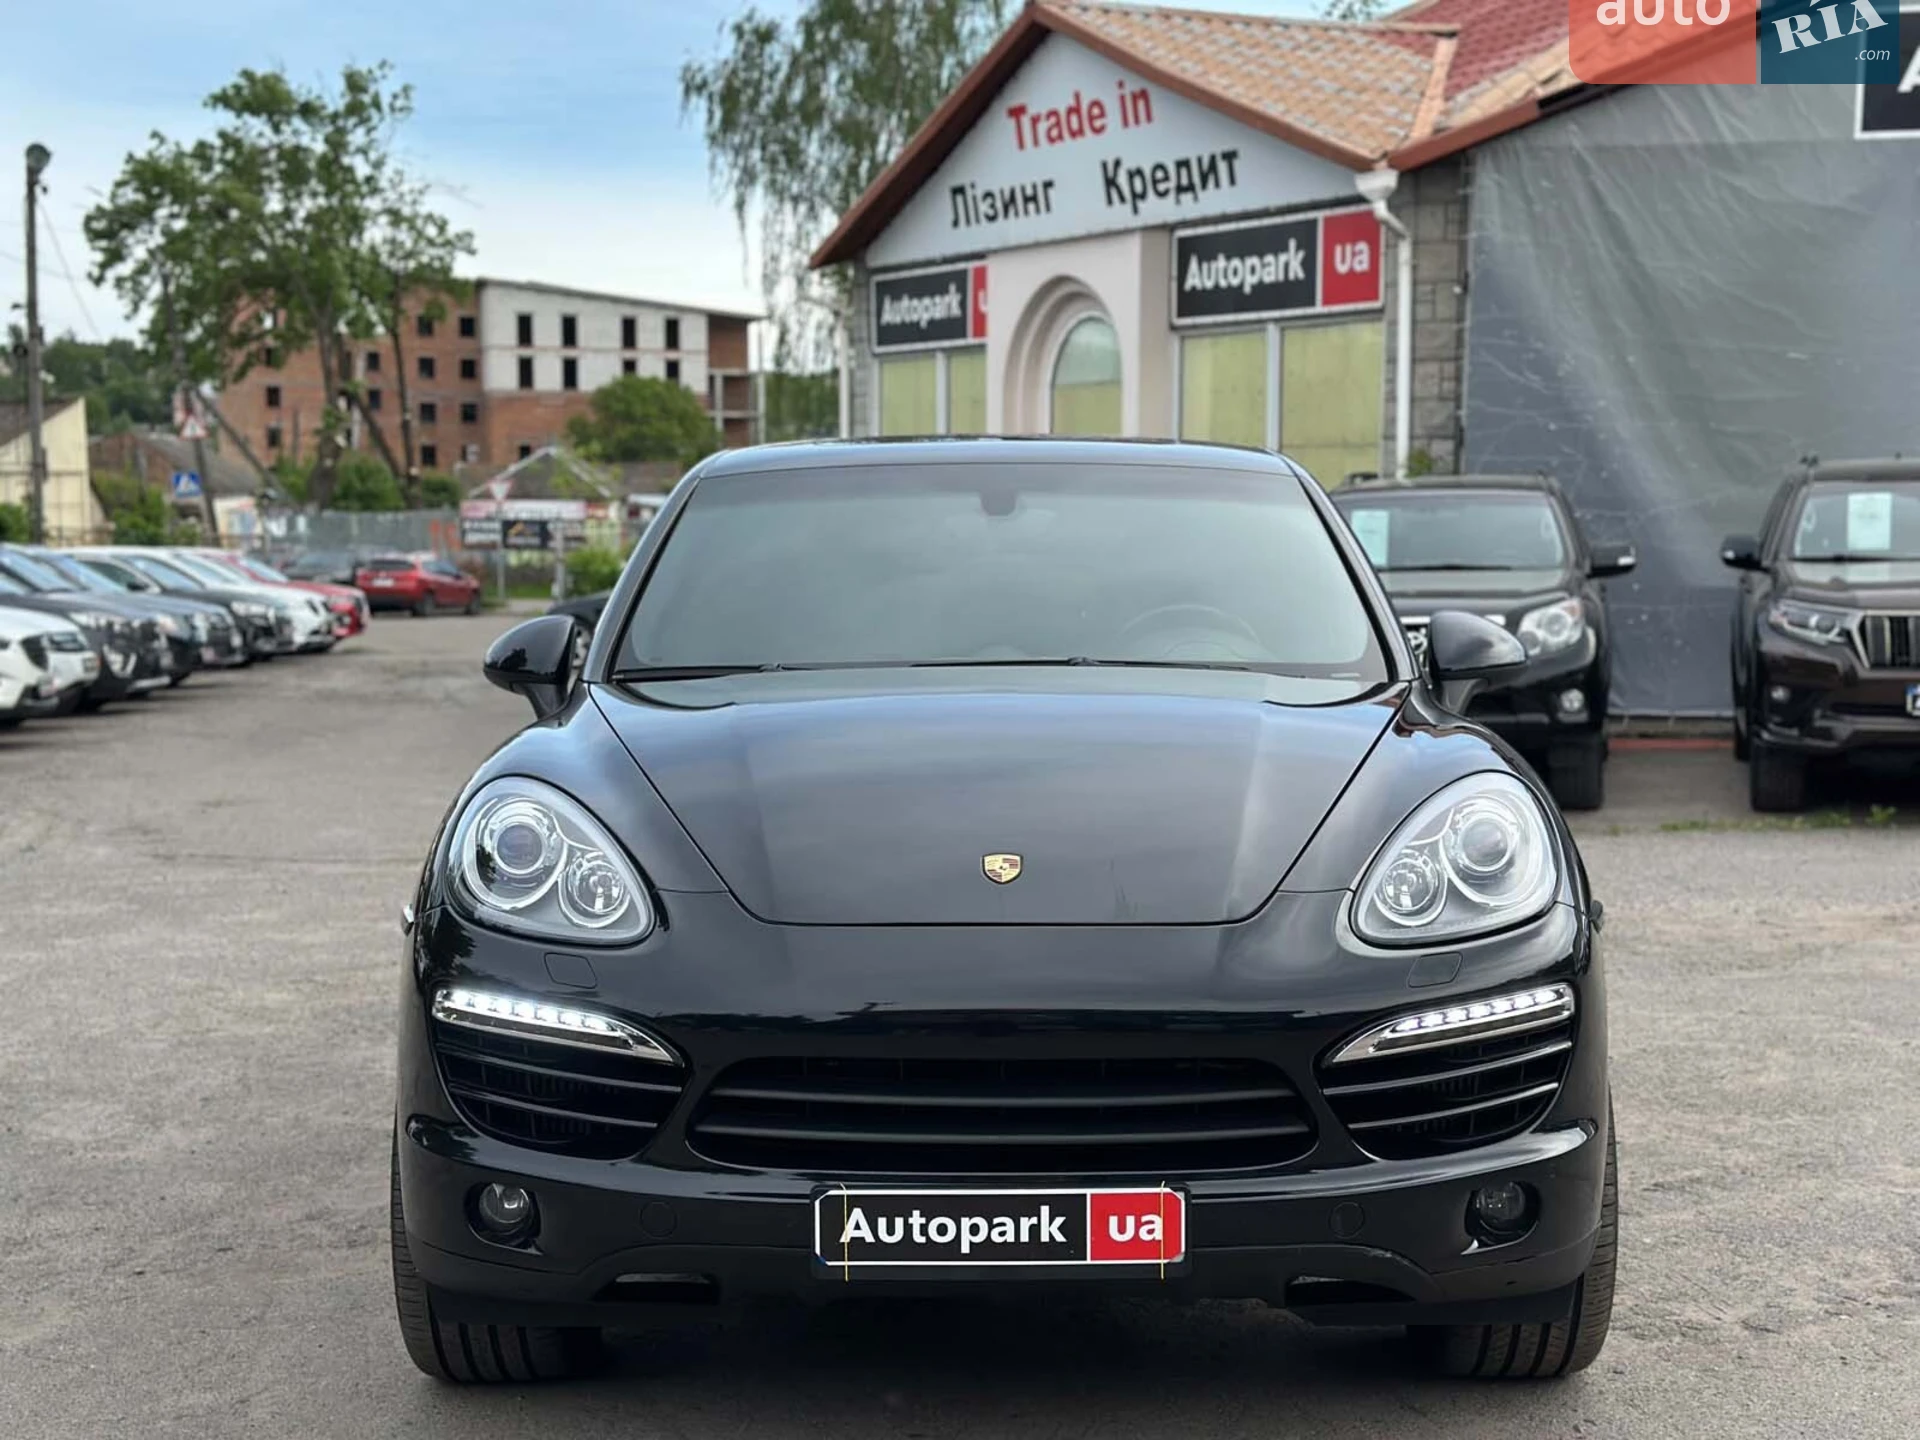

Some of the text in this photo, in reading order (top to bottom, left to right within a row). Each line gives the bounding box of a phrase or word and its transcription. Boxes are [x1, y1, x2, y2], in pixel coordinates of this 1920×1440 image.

[1006, 80, 1154, 151] Trade in
[949, 180, 1056, 229] Лізинг
[1101, 149, 1240, 215] Кредит
[1183, 237, 1370, 295] Autopark ua
[880, 282, 962, 329] Autopark
[839, 1205, 1163, 1254] Autopark ua
